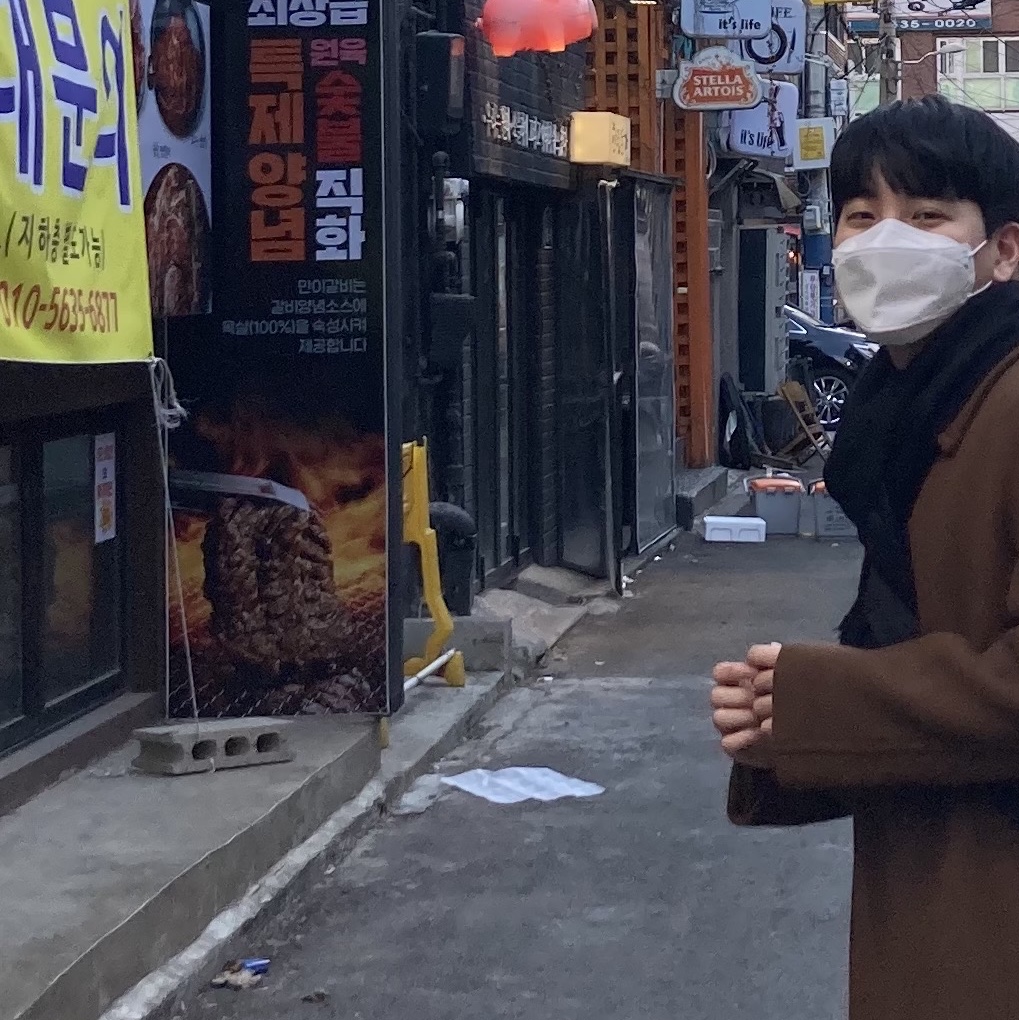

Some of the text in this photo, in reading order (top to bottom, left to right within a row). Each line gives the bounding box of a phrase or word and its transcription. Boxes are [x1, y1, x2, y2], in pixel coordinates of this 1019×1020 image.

[741, 18, 761, 30] life
[892, 19, 976, 28] 35-0020
[310, 37, 367, 66] 원육
[694, 75, 743, 86] STELLA
[693, 86, 745, 98] ARTOIS
